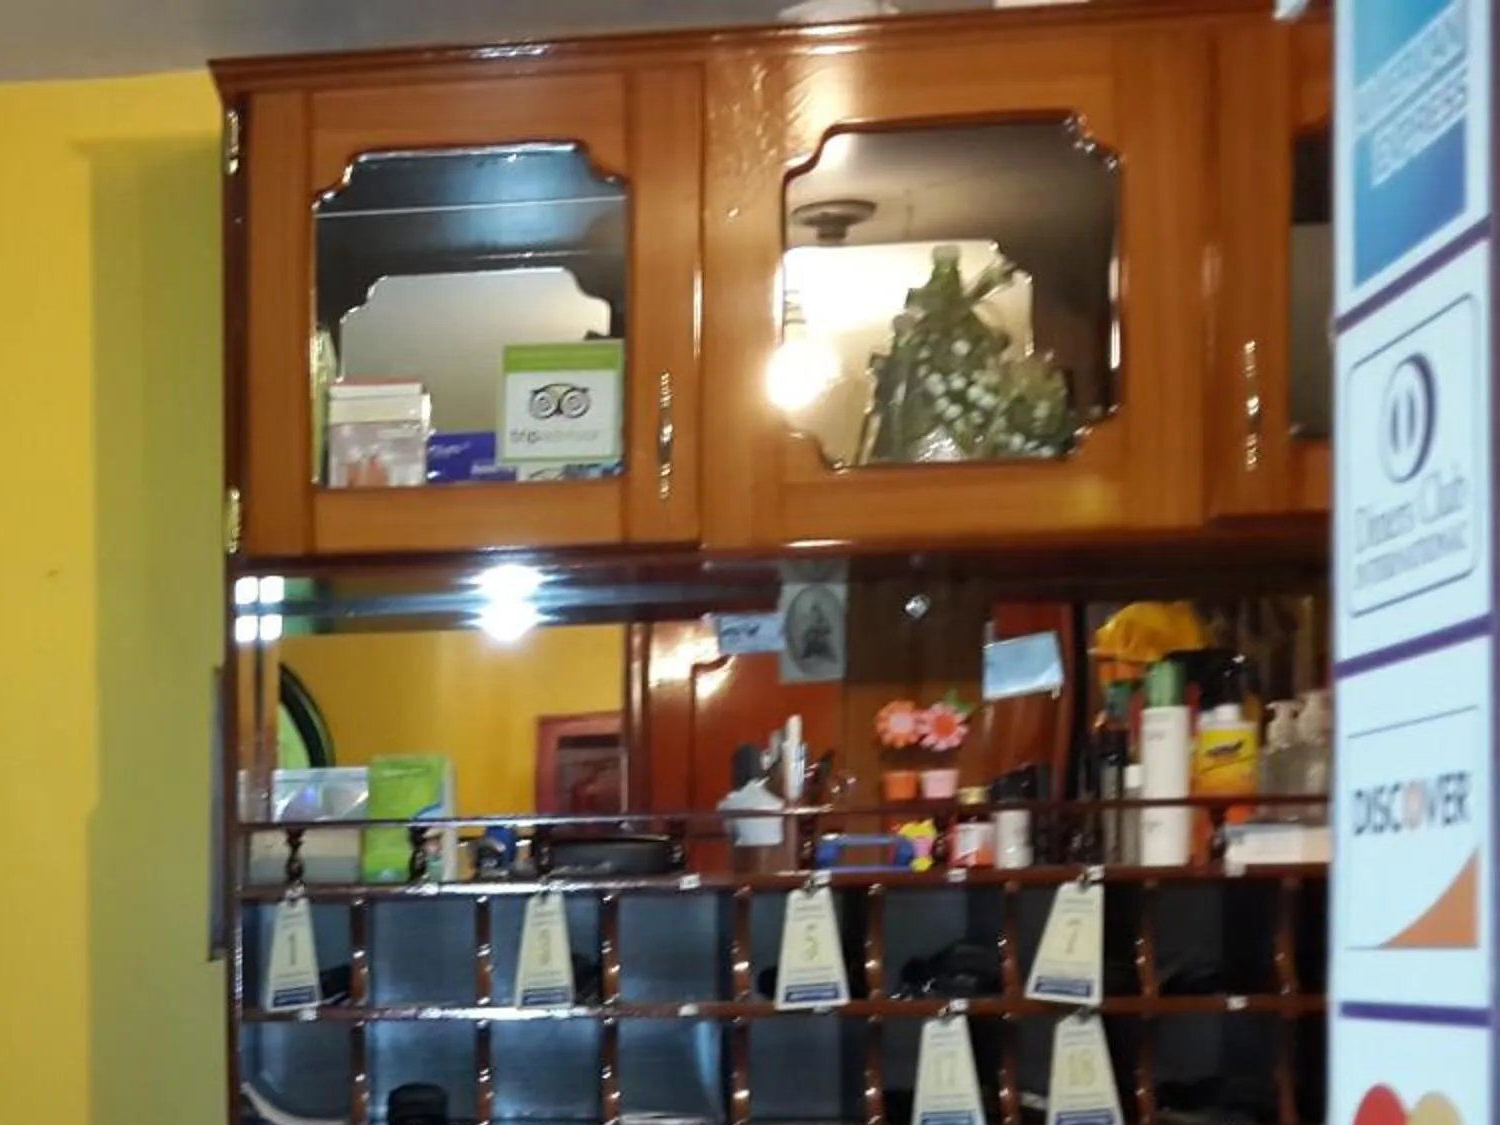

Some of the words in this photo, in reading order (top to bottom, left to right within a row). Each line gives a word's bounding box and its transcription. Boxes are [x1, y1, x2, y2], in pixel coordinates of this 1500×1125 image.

[1354, 501, 1415, 553] Diners
[1418, 461, 1466, 524] Club
[1351, 768, 1471, 837] DISCOVER
